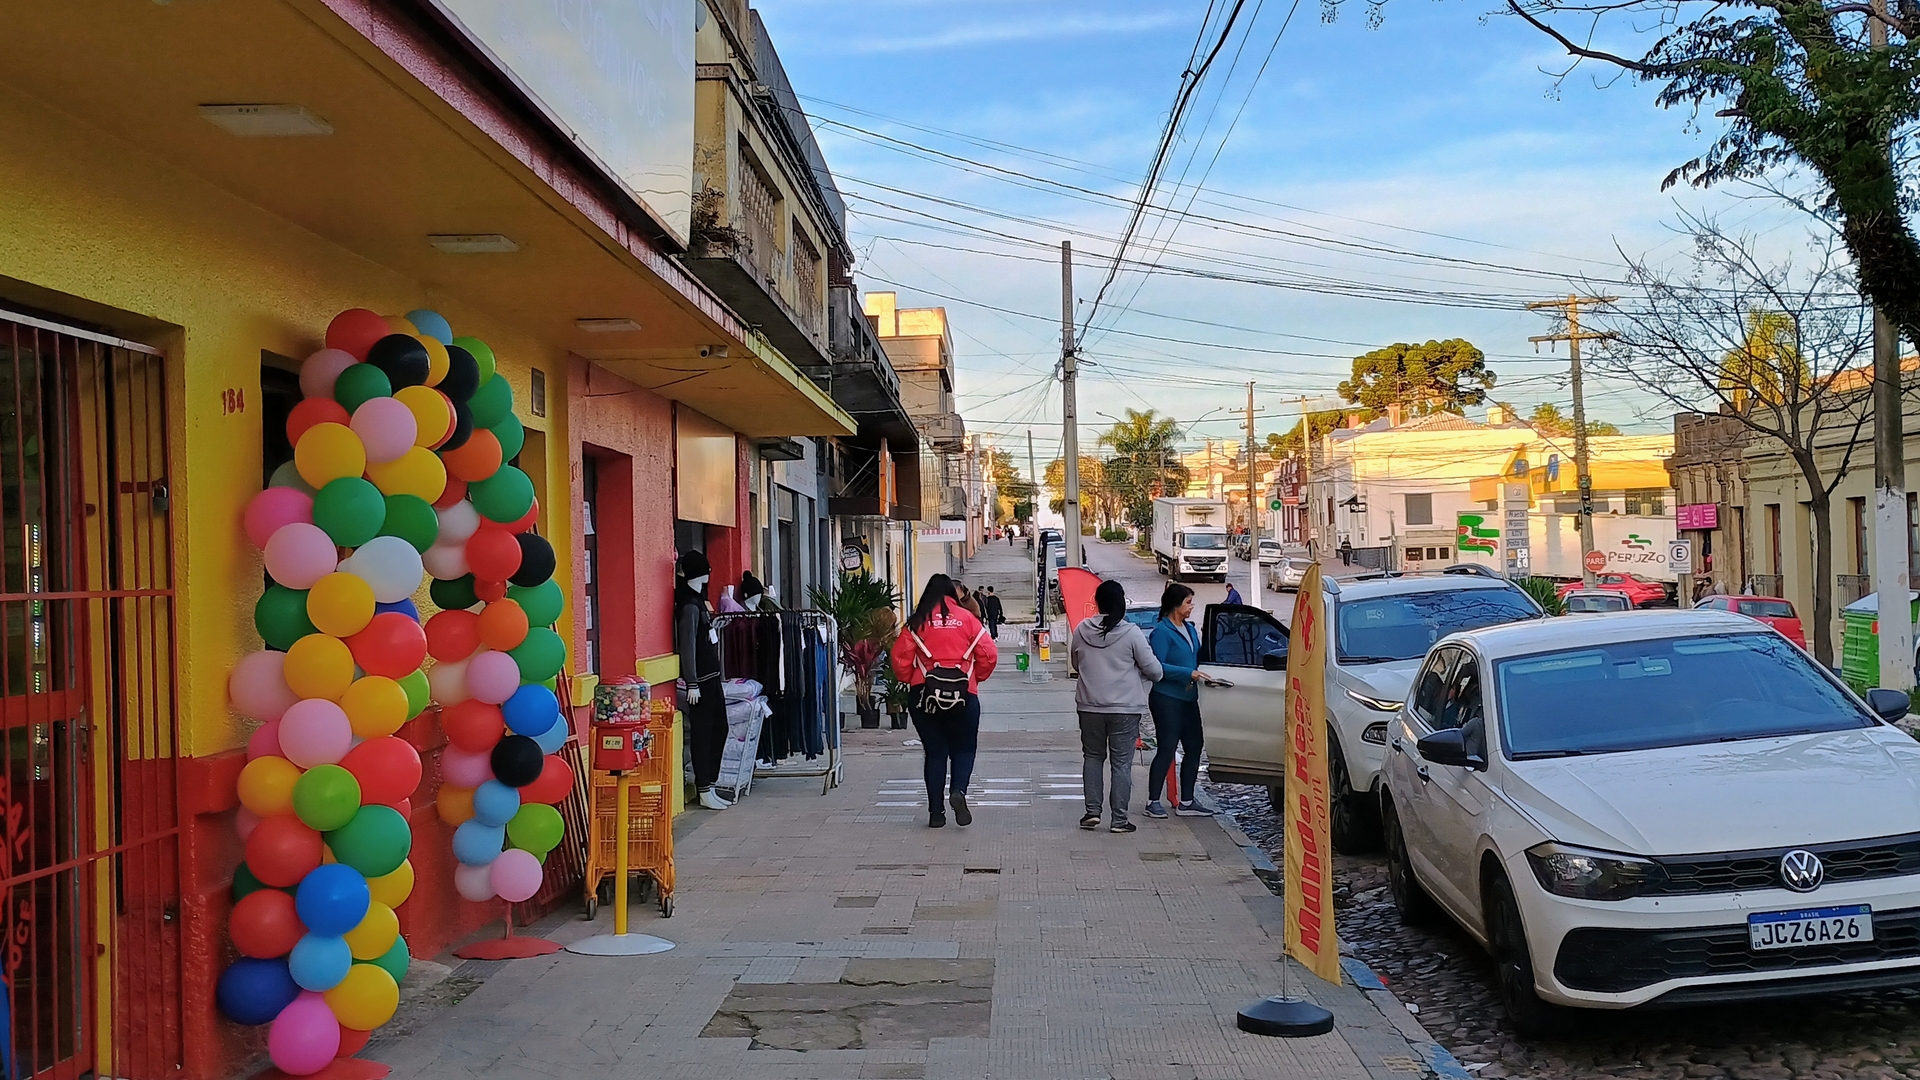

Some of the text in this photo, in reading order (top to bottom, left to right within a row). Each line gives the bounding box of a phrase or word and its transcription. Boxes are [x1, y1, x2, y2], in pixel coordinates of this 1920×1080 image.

[1607, 551, 1666, 564] PERUZZO
[1676, 548, 1683, 558] E
[1586, 557, 1605, 565] PARE
[1292, 676, 1321, 956] Mundo Real
[1761, 918, 1860, 945] JCZ6A26
